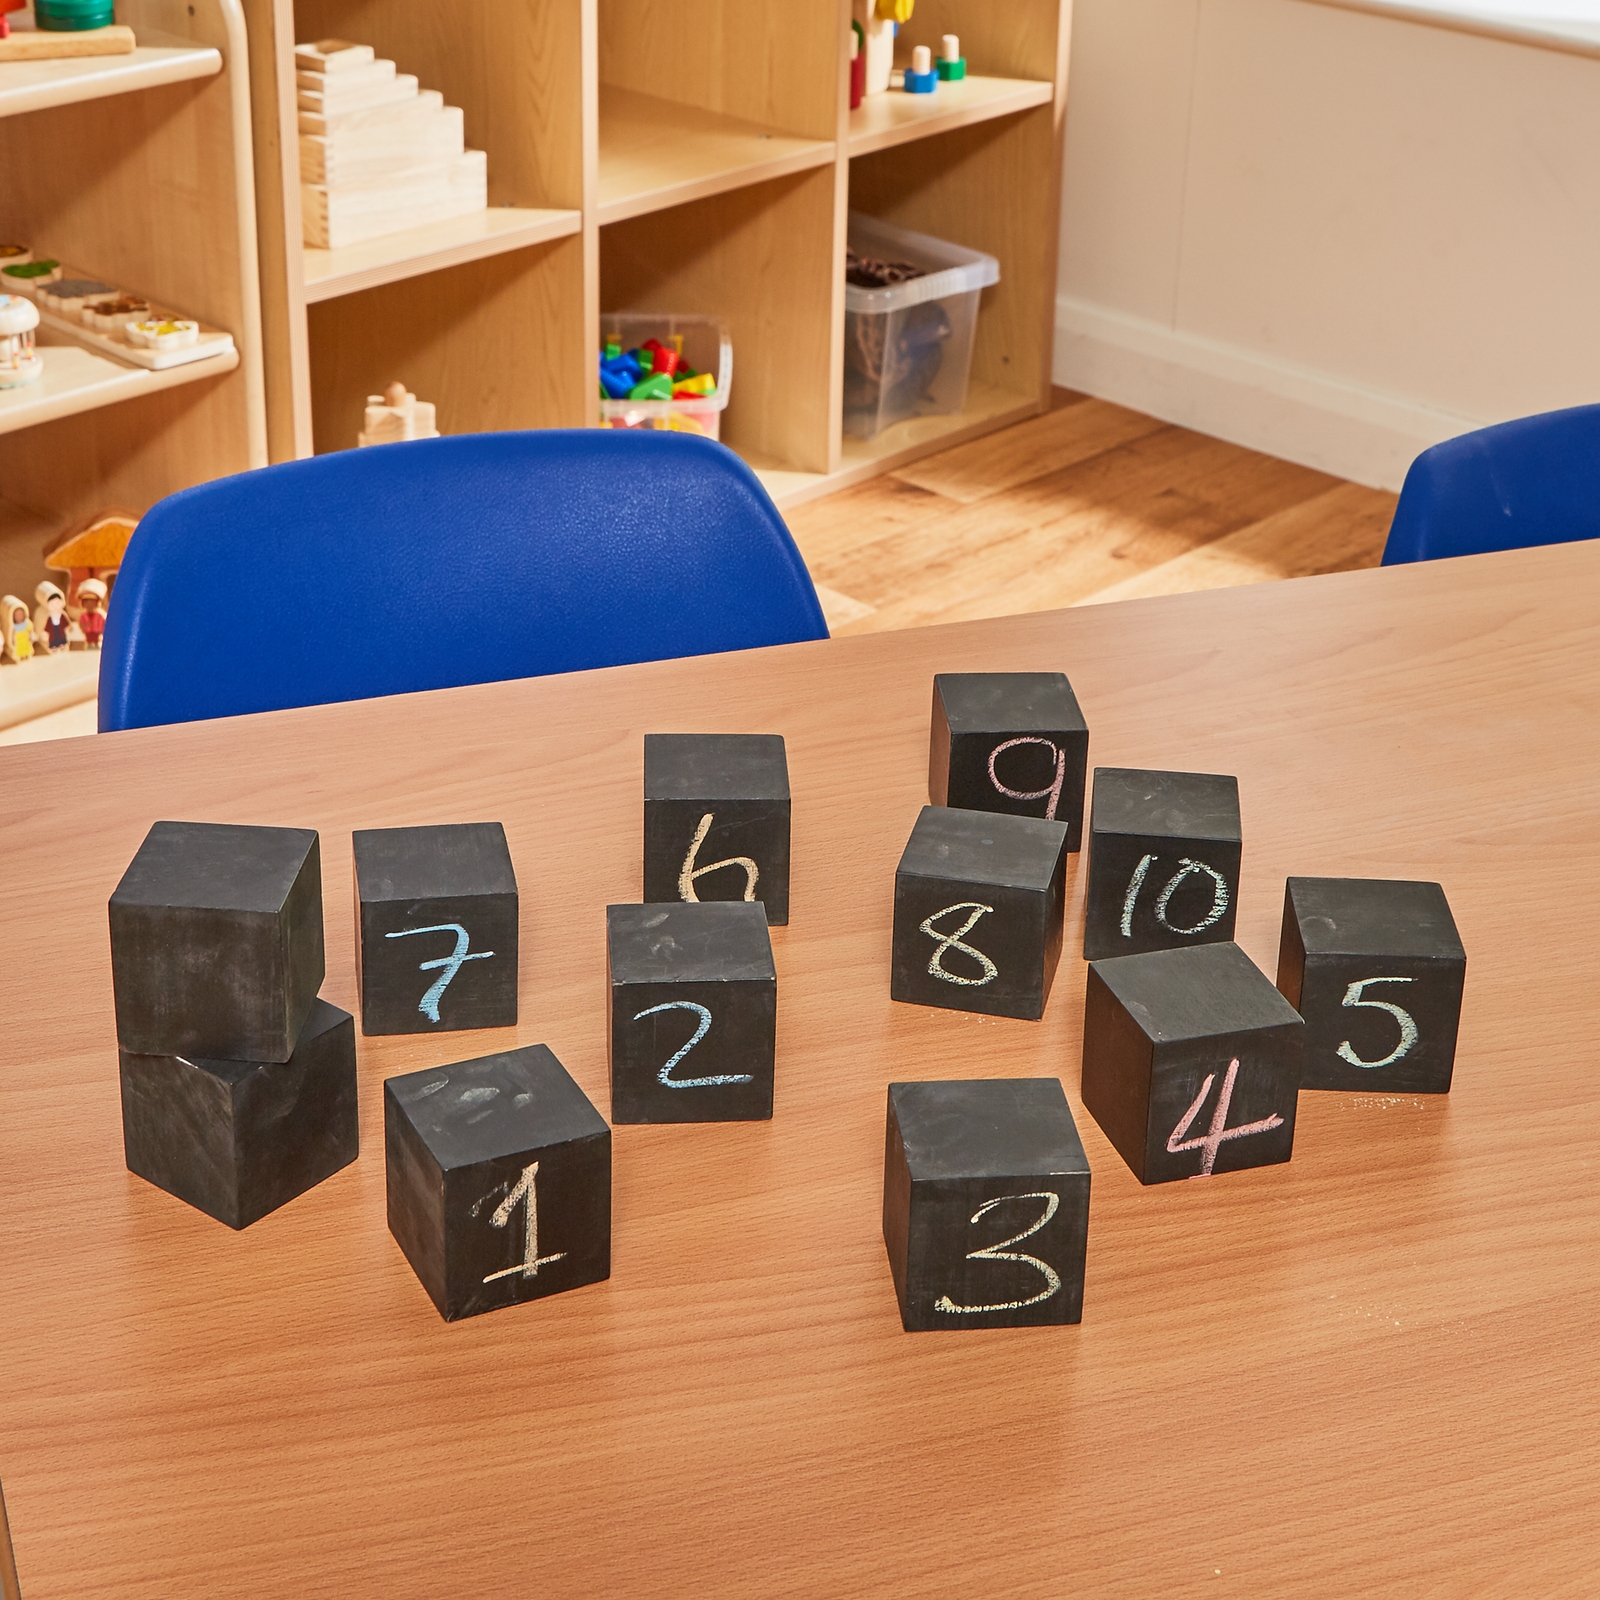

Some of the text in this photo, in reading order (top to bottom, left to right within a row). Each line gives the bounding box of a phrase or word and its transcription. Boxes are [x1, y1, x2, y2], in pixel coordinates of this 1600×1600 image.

[988, 737, 1067, 820] 9
[1120, 854, 1230, 938] 10
[384, 923, 495, 1024] 7
[919, 902, 998, 987] 8
[633, 1001, 754, 1089] 2
[1336, 977, 1420, 1069] 5
[1166, 1058, 1285, 1179] 4
[471, 1160, 568, 1284] 1
[934, 1191, 1062, 1314] 3
